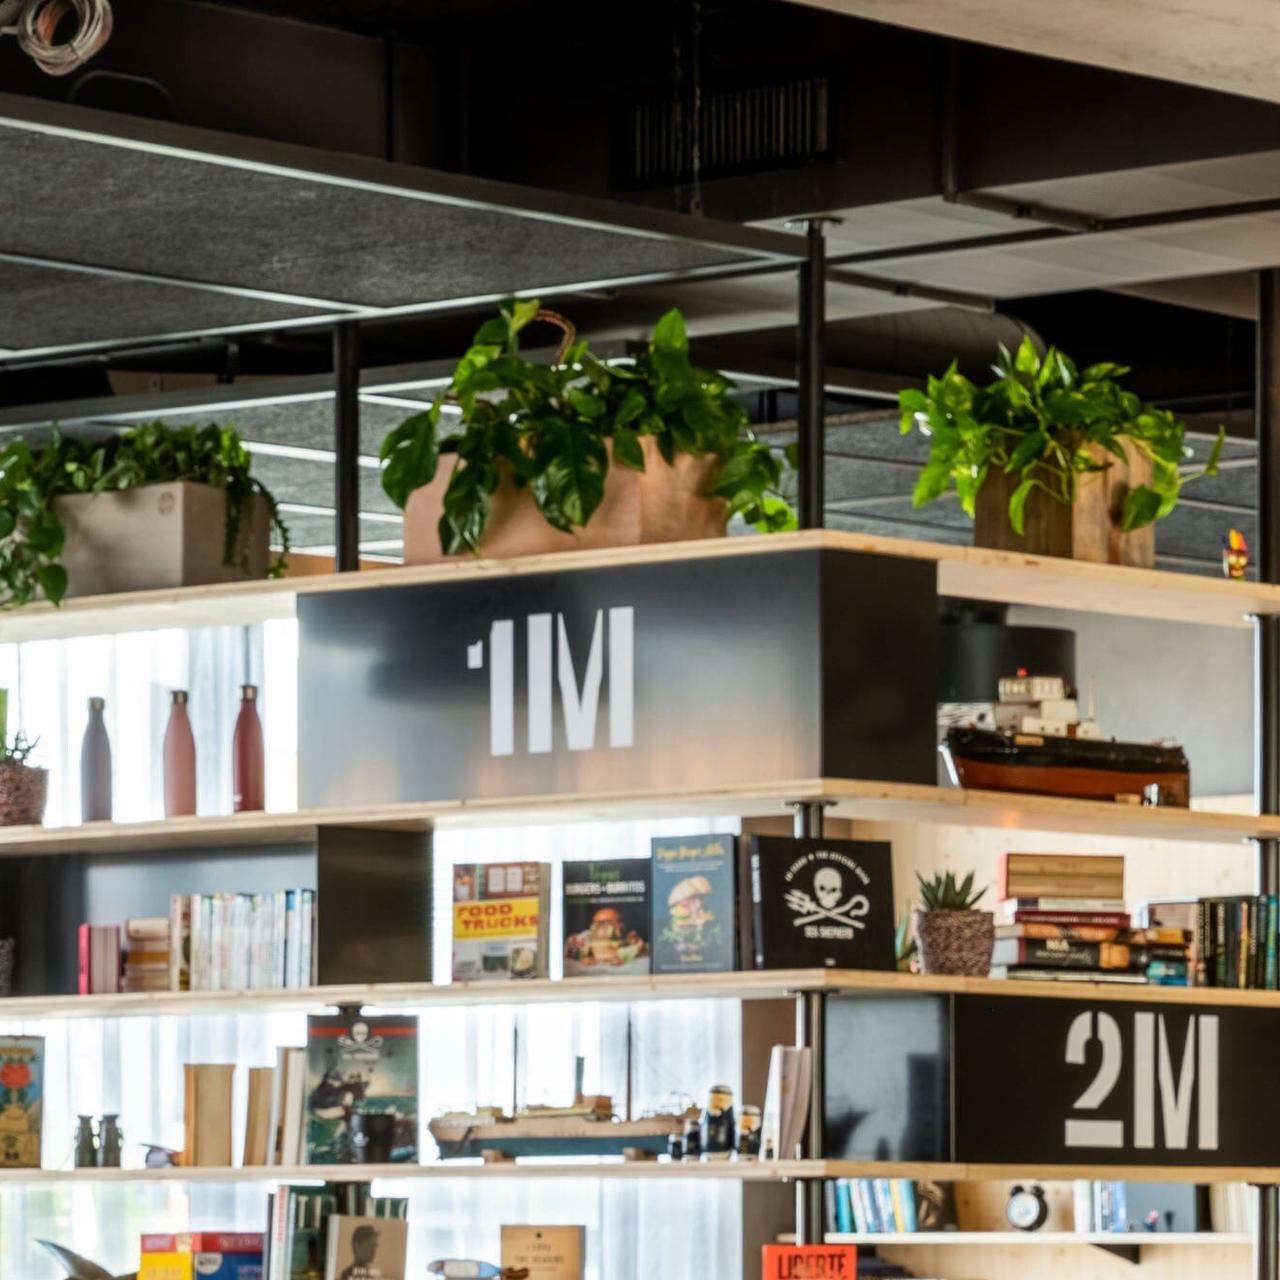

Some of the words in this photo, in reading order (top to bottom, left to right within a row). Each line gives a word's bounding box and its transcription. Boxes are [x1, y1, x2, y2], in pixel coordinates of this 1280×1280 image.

[467, 606, 634, 756] 1M
[457, 904, 513, 919] FOOD
[462, 916, 539, 932] TRUCKS
[1065, 1010, 1219, 1150] 2M
